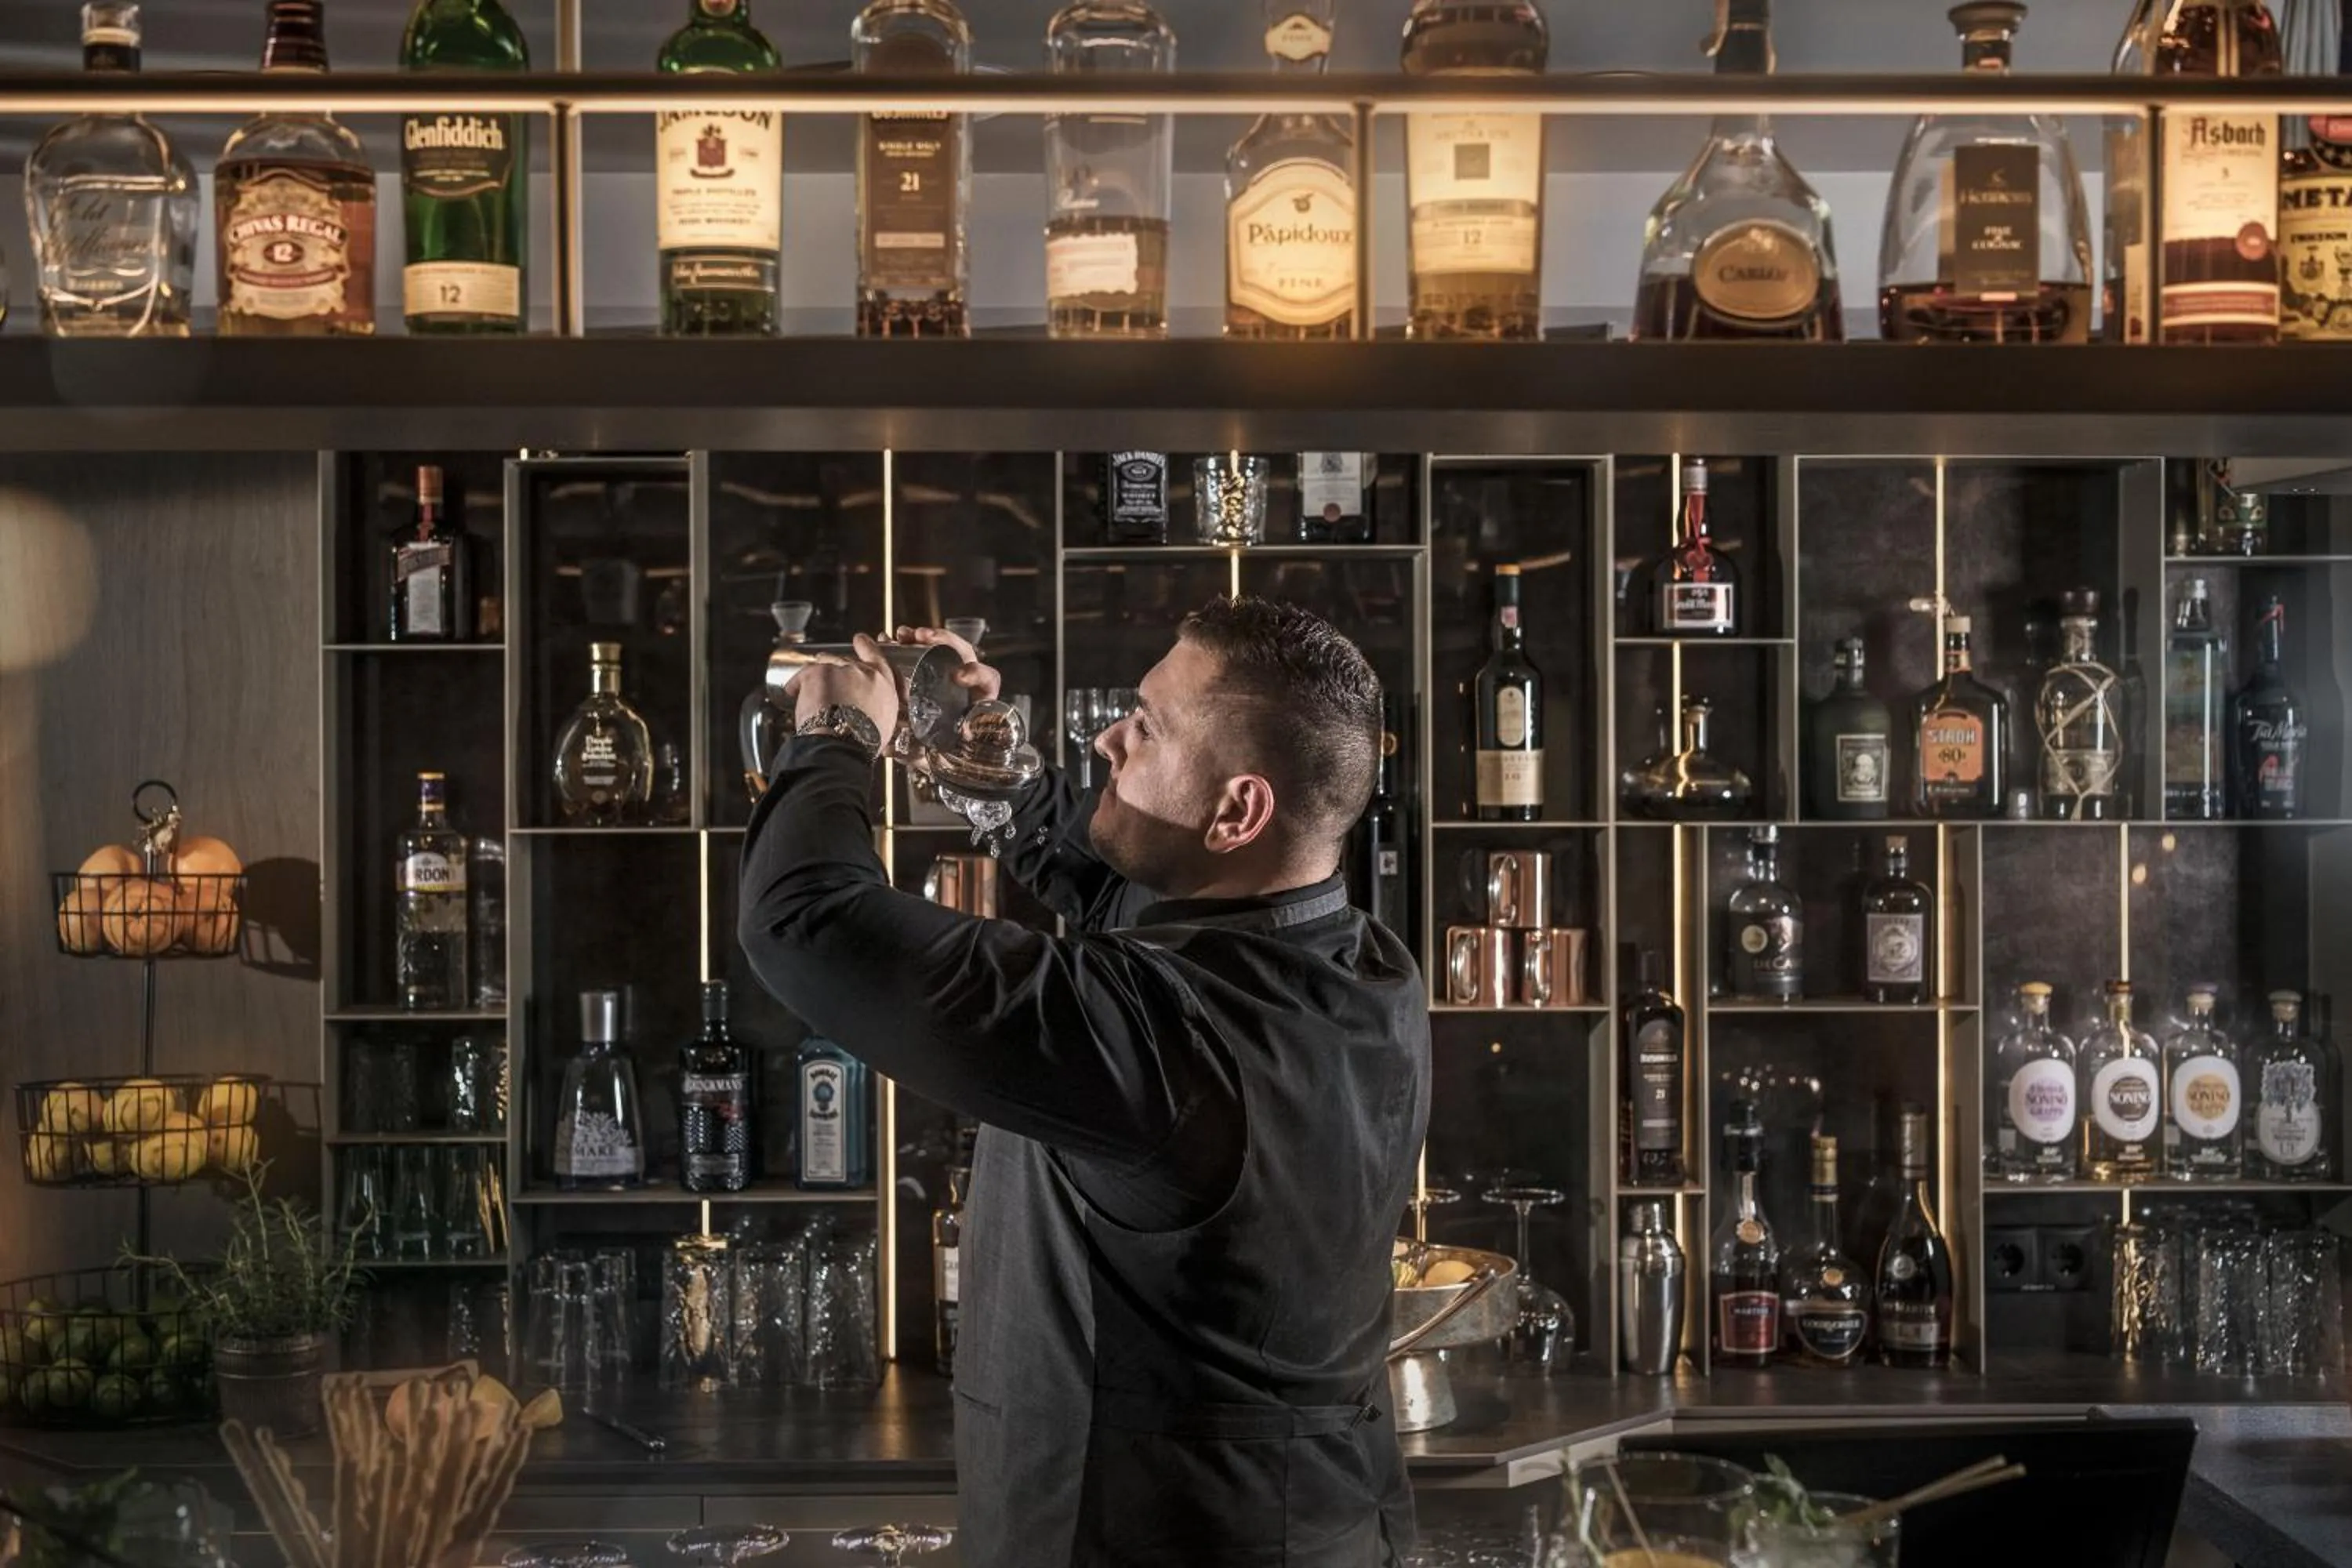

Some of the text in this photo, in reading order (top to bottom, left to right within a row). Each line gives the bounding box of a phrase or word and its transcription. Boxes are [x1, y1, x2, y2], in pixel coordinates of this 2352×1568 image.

[405, 115, 503, 151] Glenfiddich
[2190, 118, 2266, 146] Asbach
[899, 170, 920, 191] 21
[1464, 230, 1482, 245] 12
[440, 284, 461, 303] 12
[1926, 728, 1976, 745] STROH
